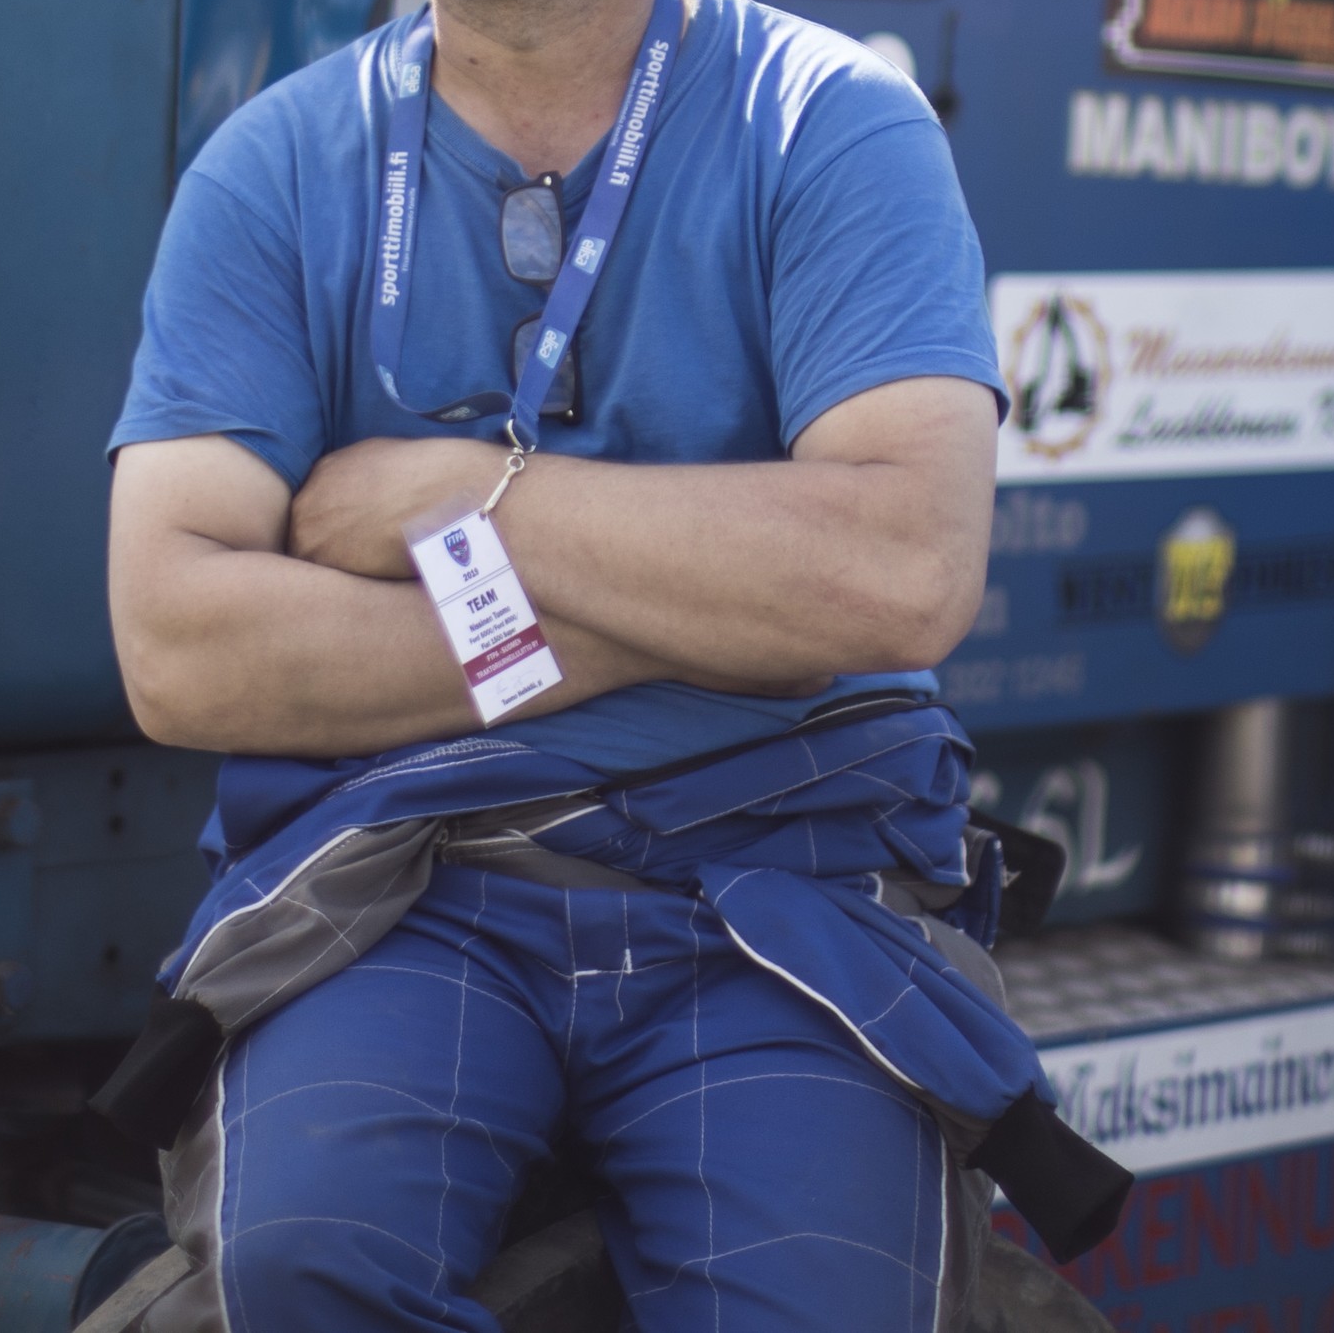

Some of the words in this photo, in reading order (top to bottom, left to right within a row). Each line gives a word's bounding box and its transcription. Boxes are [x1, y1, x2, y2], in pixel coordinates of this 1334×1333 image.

[609, 39, 669, 186] sporttimobiili.fi
[381, 151, 408, 306] sporttimobiili.fi
[574, 238, 596, 267] elisa
[539, 329, 560, 359] elisa
[466, 588, 499, 614] TEAM
